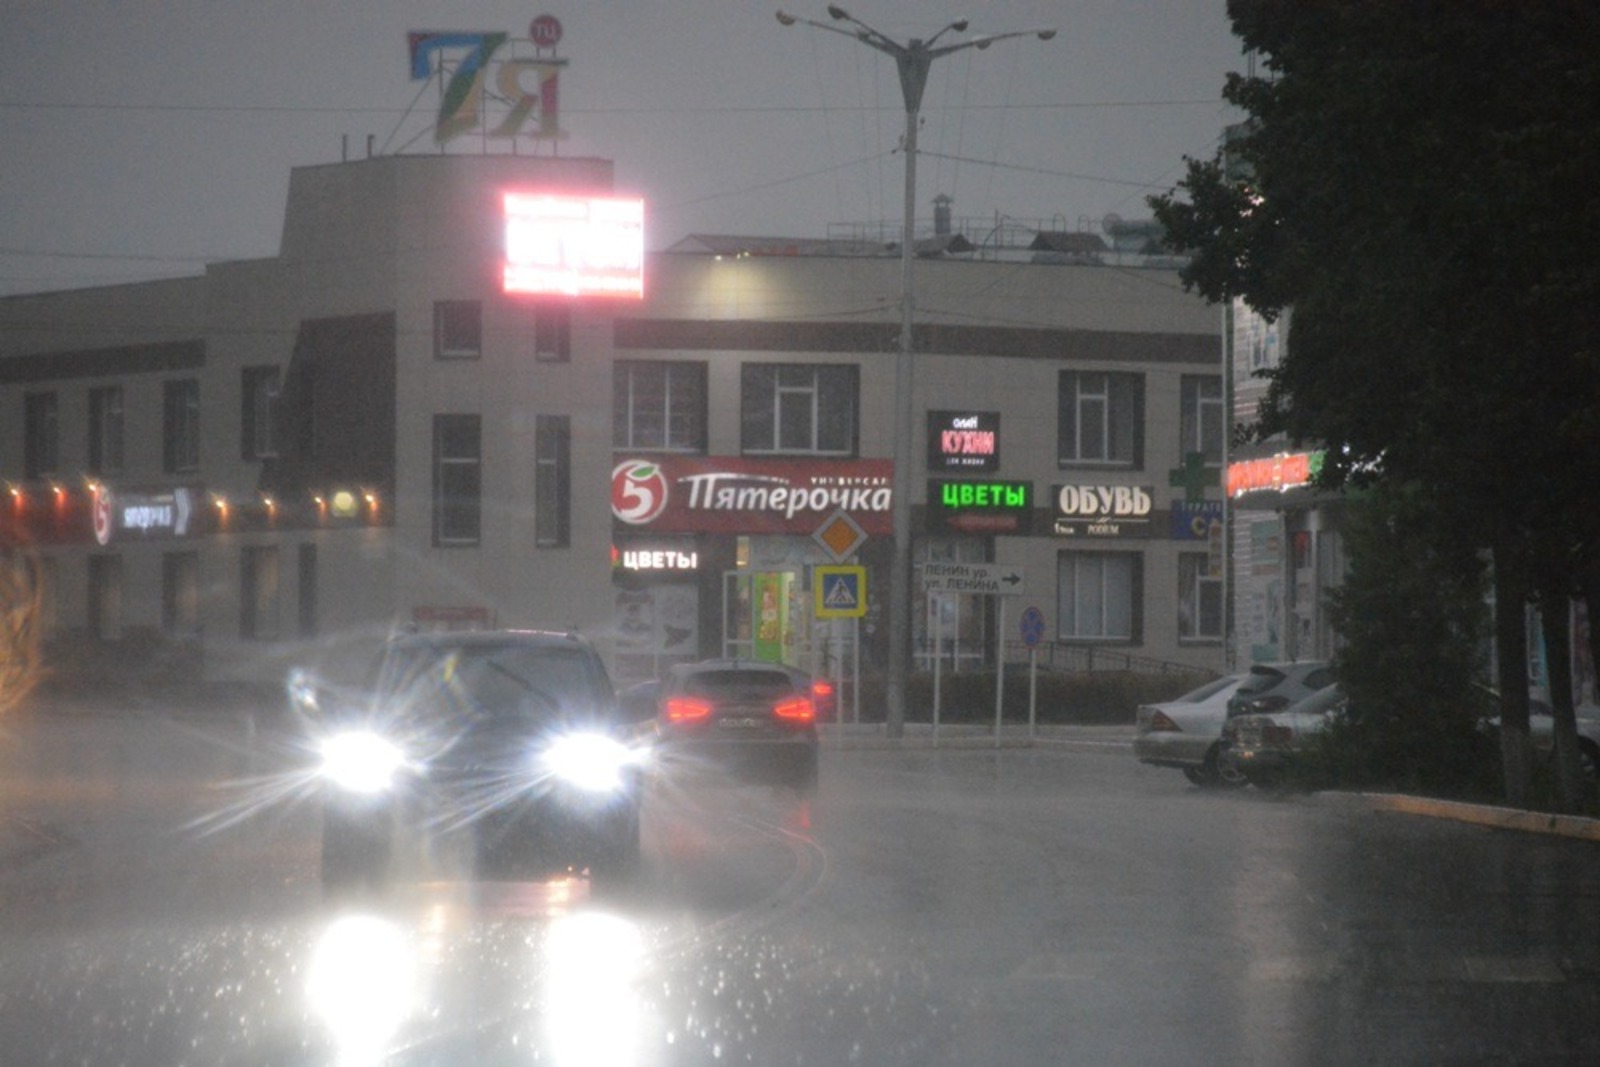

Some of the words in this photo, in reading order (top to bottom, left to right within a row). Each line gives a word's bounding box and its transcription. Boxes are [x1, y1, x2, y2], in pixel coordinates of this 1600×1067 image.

[942, 430, 994, 454] КУХНИ
[942, 483, 1025, 508] ЦВЕТЫ
[1059, 484, 1151, 515] ОБУВЬ
[622, 551, 698, 571] ЦВЕТЫ
[925, 564, 969, 576] ЛЕНИН
[945, 578, 1000, 591] ЛЕНИНА
